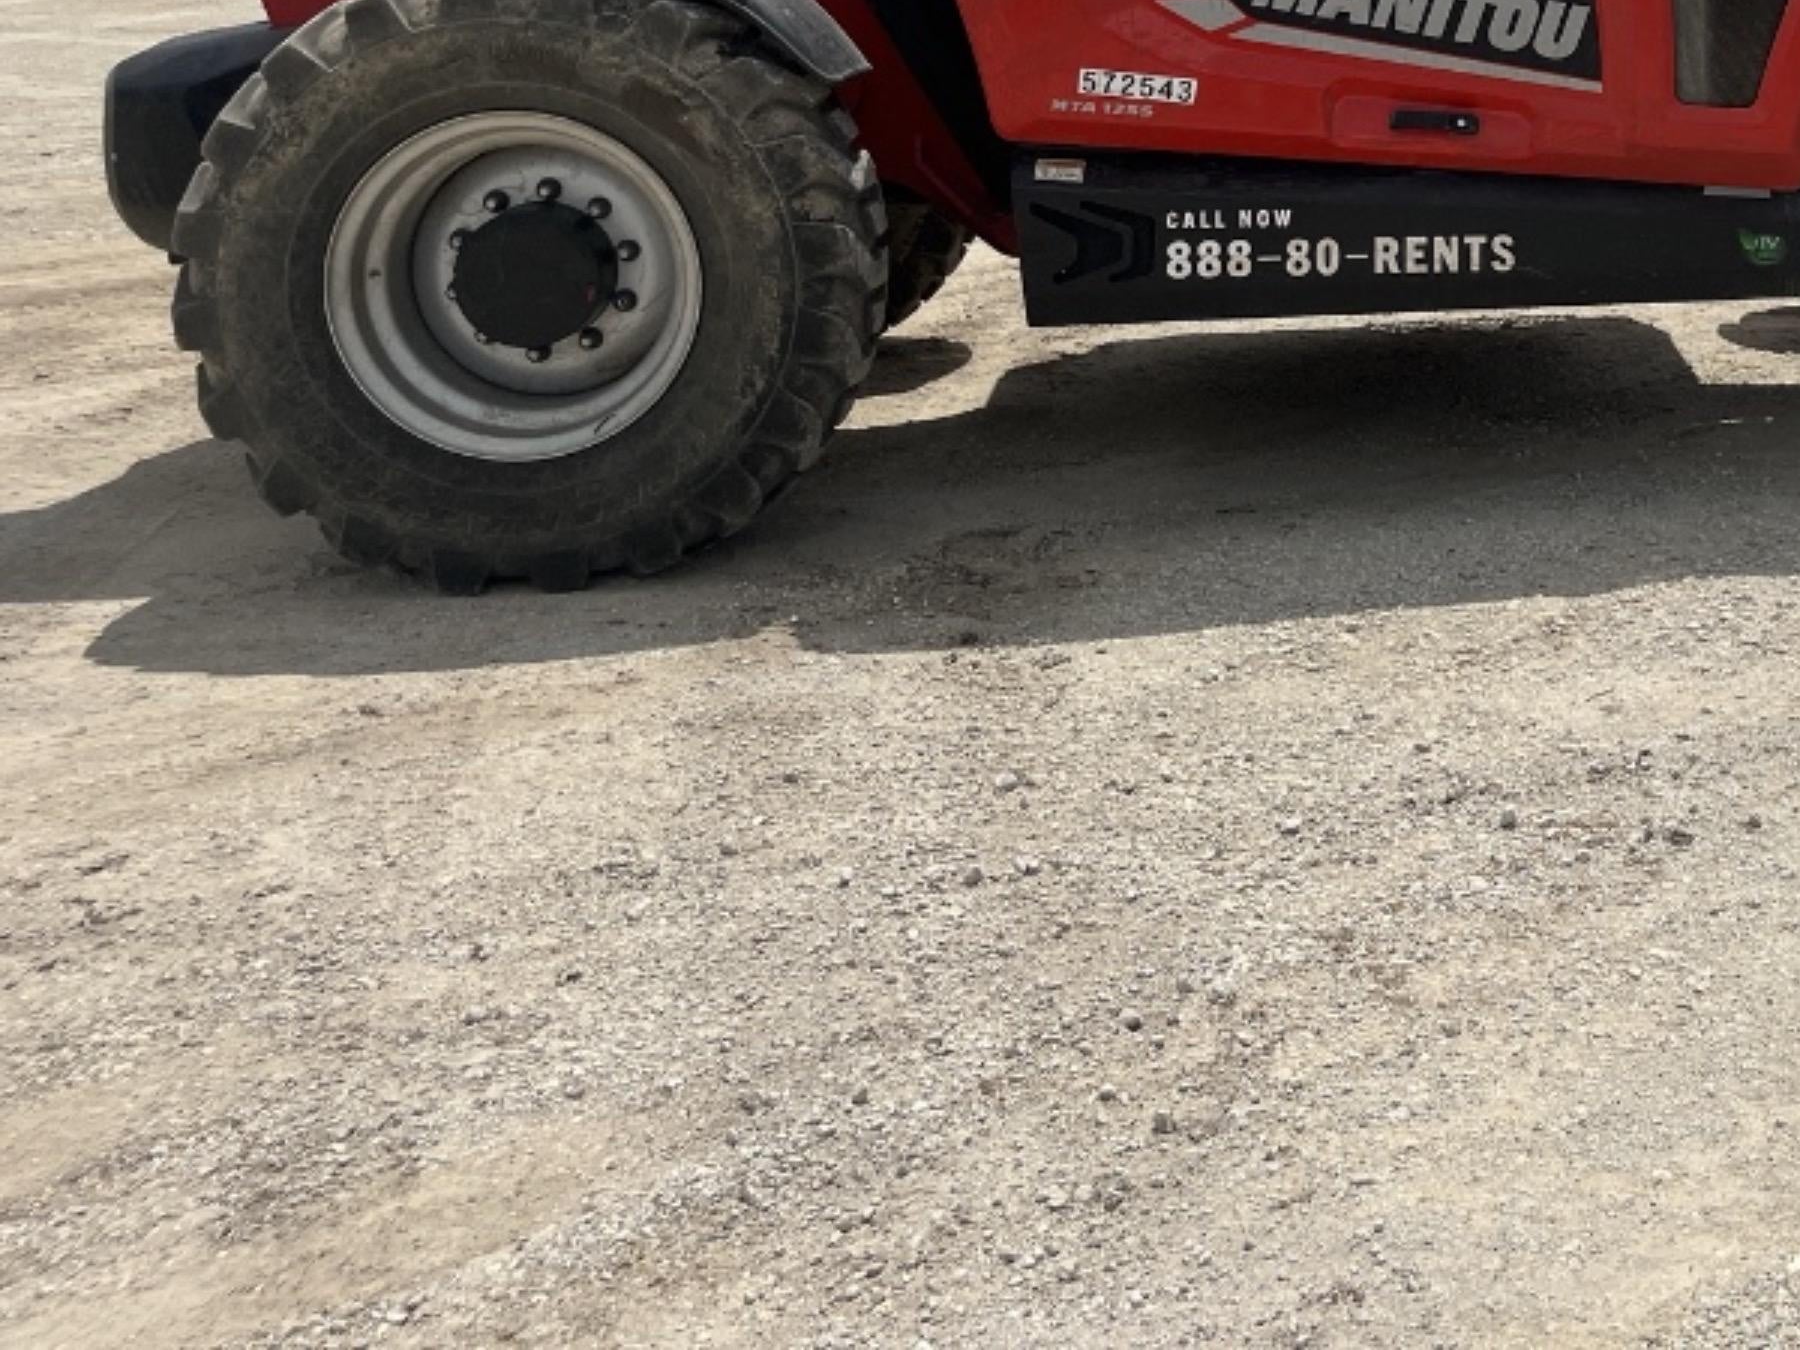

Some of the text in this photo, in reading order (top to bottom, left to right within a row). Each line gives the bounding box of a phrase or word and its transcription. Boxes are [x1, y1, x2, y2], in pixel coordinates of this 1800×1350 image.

[1081, 71, 1193, 103] 572543
[1165, 208, 1292, 230] CALL NOW
[1166, 233, 1517, 279] 888-80-RENTS
